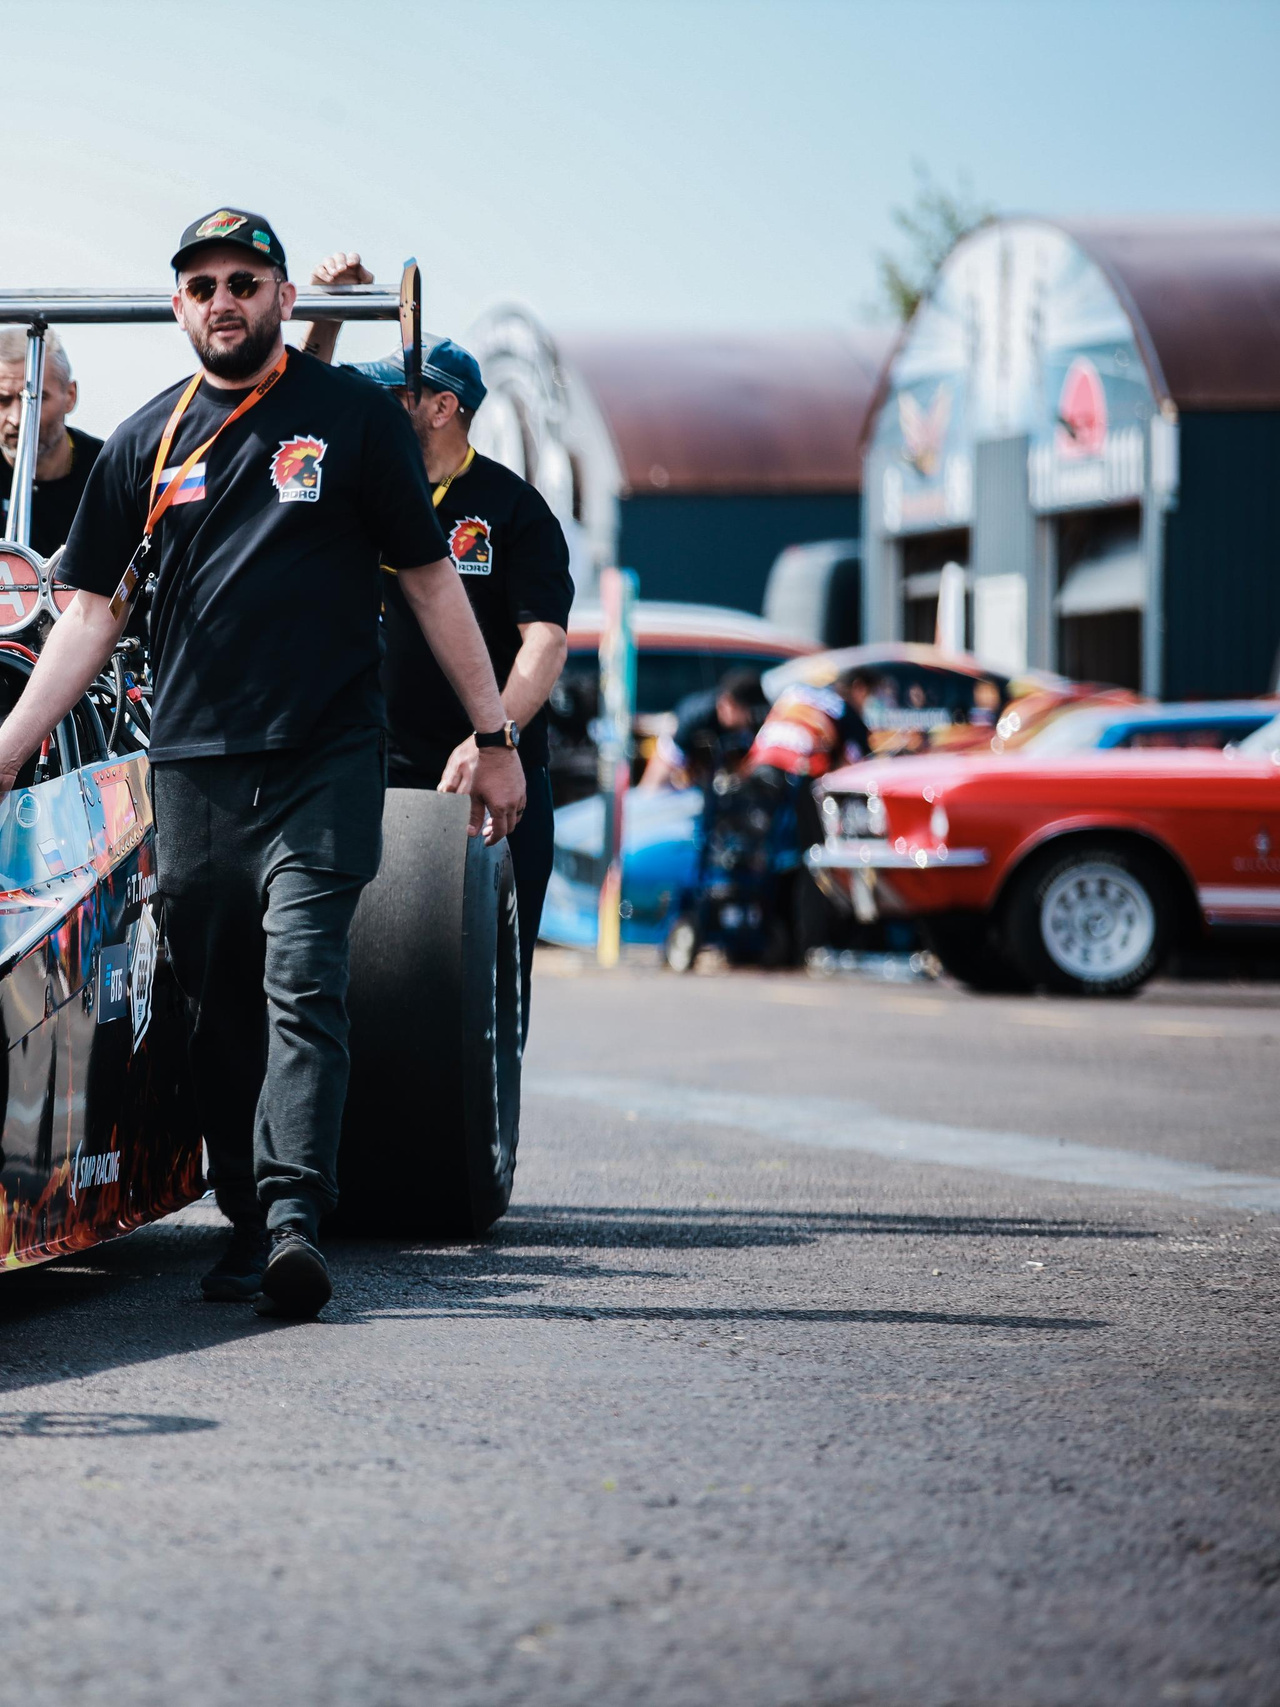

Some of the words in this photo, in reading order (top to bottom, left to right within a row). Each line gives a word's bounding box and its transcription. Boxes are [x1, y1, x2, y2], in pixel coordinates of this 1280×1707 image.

[282, 489, 318, 499] RDRC
[458, 564, 490, 573] RDRC
[110, 968, 123, 1004] ВТБ
[79, 1155, 96, 1190] SMP
[94, 1150, 121, 1186] RACING
